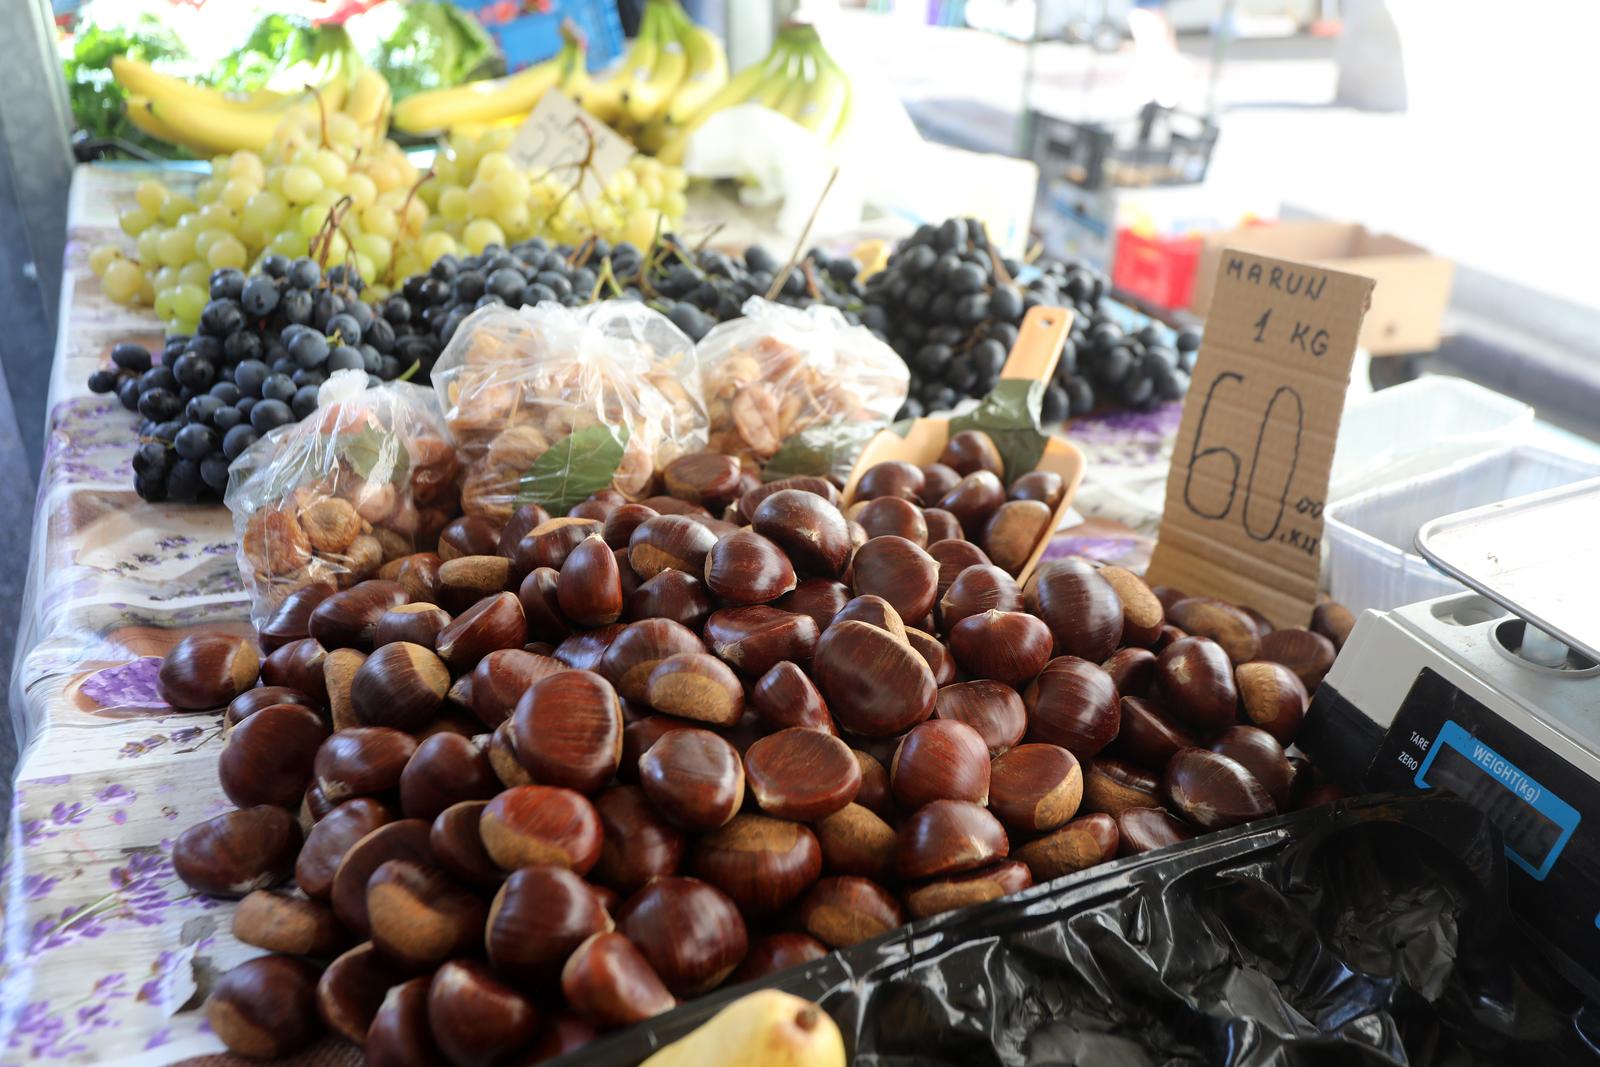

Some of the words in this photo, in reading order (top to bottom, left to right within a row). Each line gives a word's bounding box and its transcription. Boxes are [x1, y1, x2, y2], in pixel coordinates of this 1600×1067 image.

[1252, 307, 1272, 343] 1
[1290, 320, 1330, 357] KG
[1184, 371, 1303, 542] 60
[1397, 751, 1418, 772] ZERO
[1410, 730, 1429, 751] TARE
[1473, 744, 1541, 804] WEIGHT(kg)
